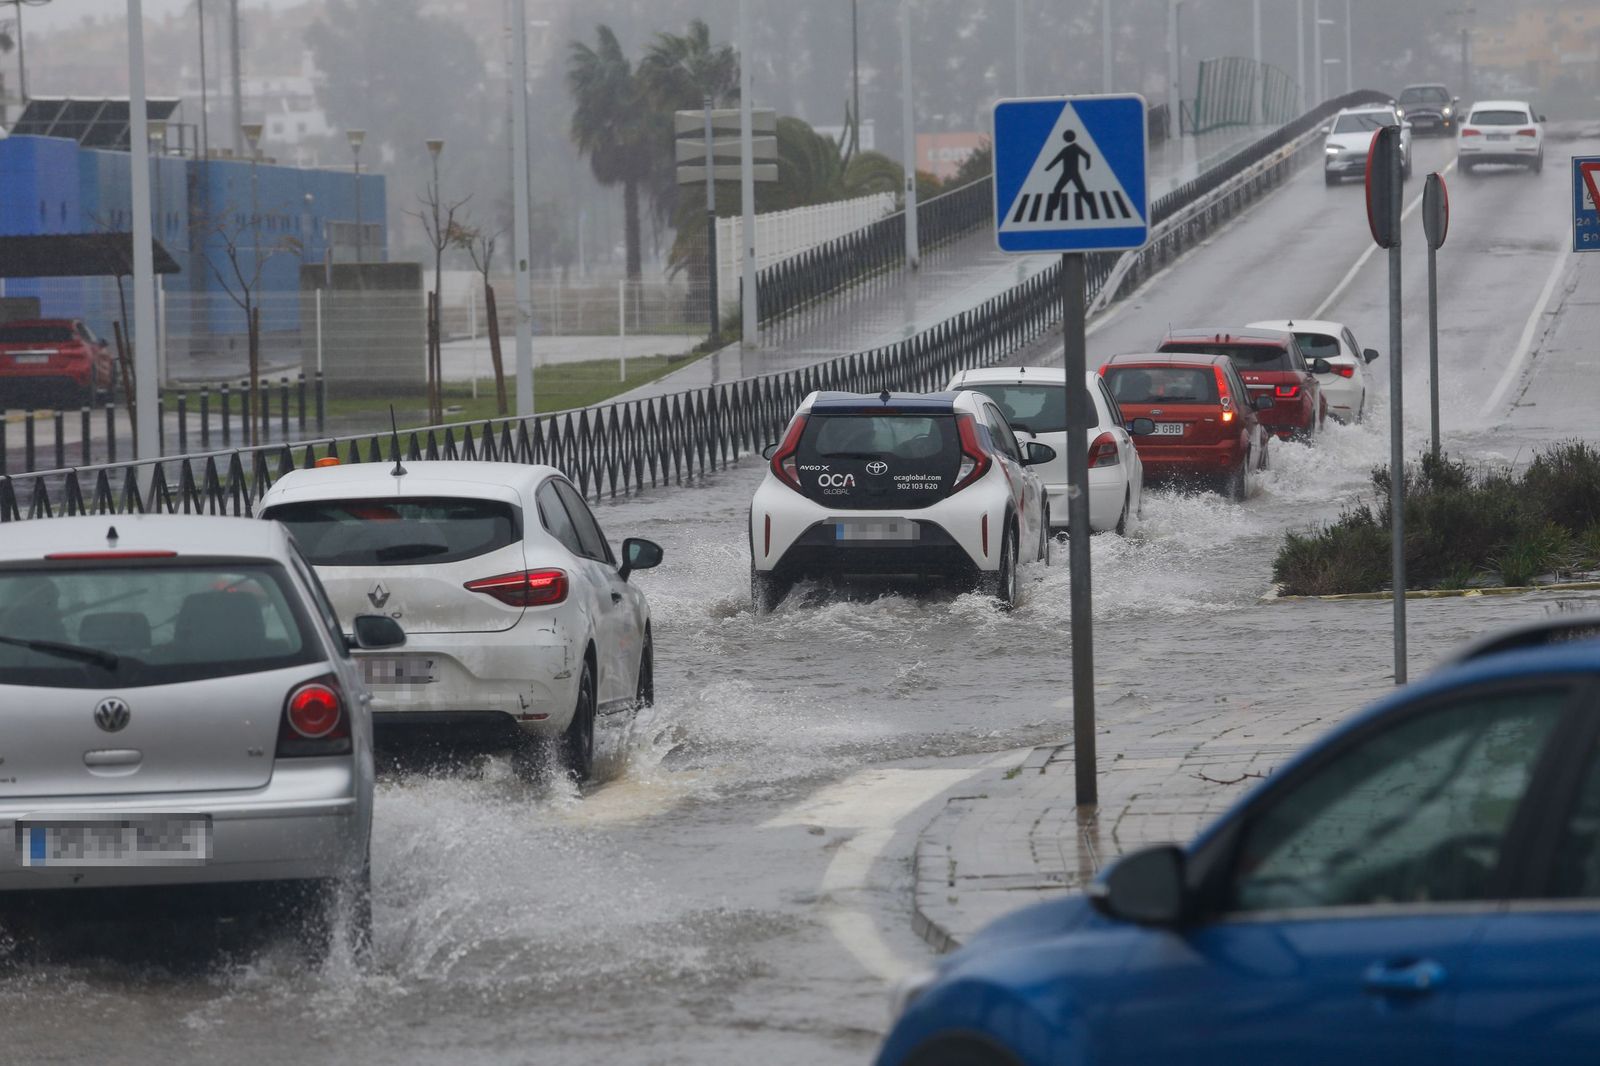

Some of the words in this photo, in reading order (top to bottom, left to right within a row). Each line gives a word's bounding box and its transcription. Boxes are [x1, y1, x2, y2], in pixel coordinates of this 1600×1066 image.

[1162, 424, 1181, 434] GBB
[818, 473, 856, 487] OCA
[893, 474, 942, 482] ocaglobal.com
